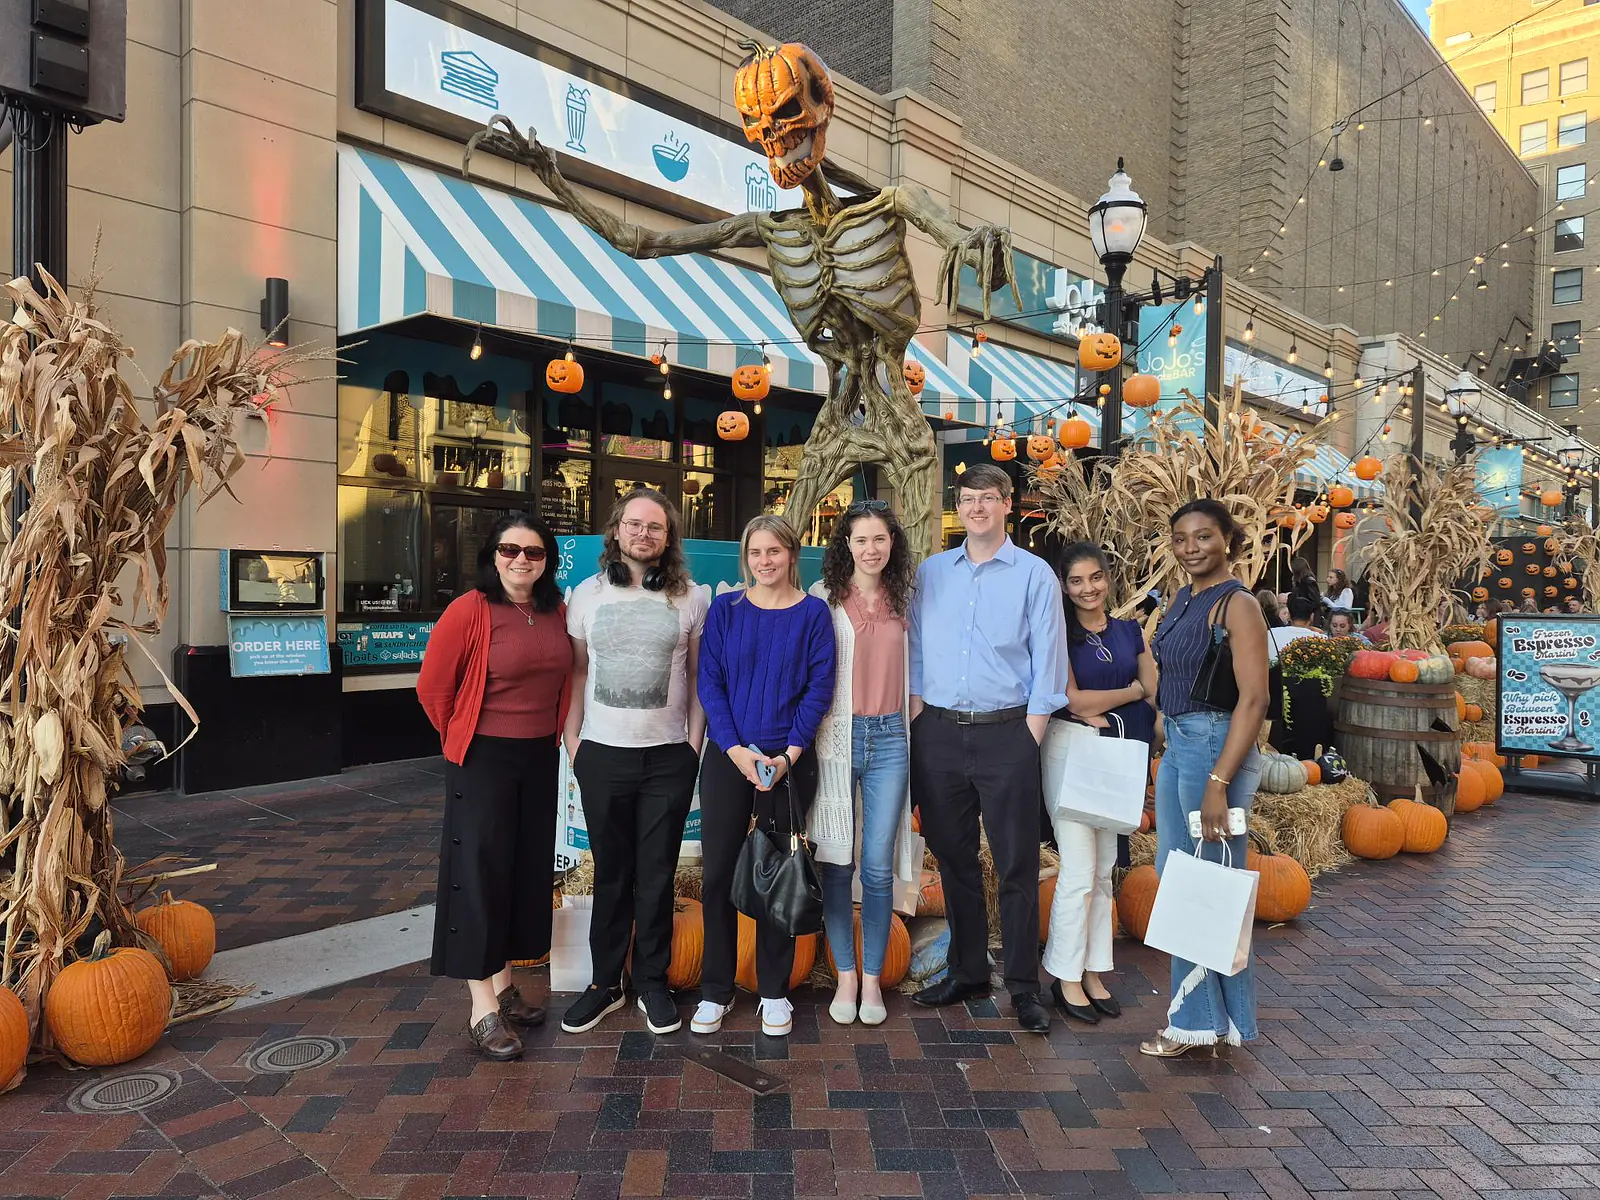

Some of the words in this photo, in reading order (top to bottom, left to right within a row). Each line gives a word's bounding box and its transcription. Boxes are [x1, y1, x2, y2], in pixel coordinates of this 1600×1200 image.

[555, 570, 568, 580] AR
[338, 632, 353, 641] OT
[371, 631, 404, 639] WRAPS
[1534, 629, 1572, 639] Frozen
[231, 641, 282, 653] ORDER
[285, 640, 321, 651] HERE
[1514, 636, 1595, 652] Espresso
[343, 650, 378, 664] floats
[392, 649, 418, 660] salads
[1535, 649, 1576, 659] Martini
[1502, 693, 1529, 704] Why
[1532, 692, 1558, 704] pick
[1504, 704, 1554, 714] Between
[1503, 715, 1567, 726] Espresso
[1504, 725, 1514, 735] &
[1515, 725, 1564, 735] Martini?
[556, 854, 570, 870] ER
